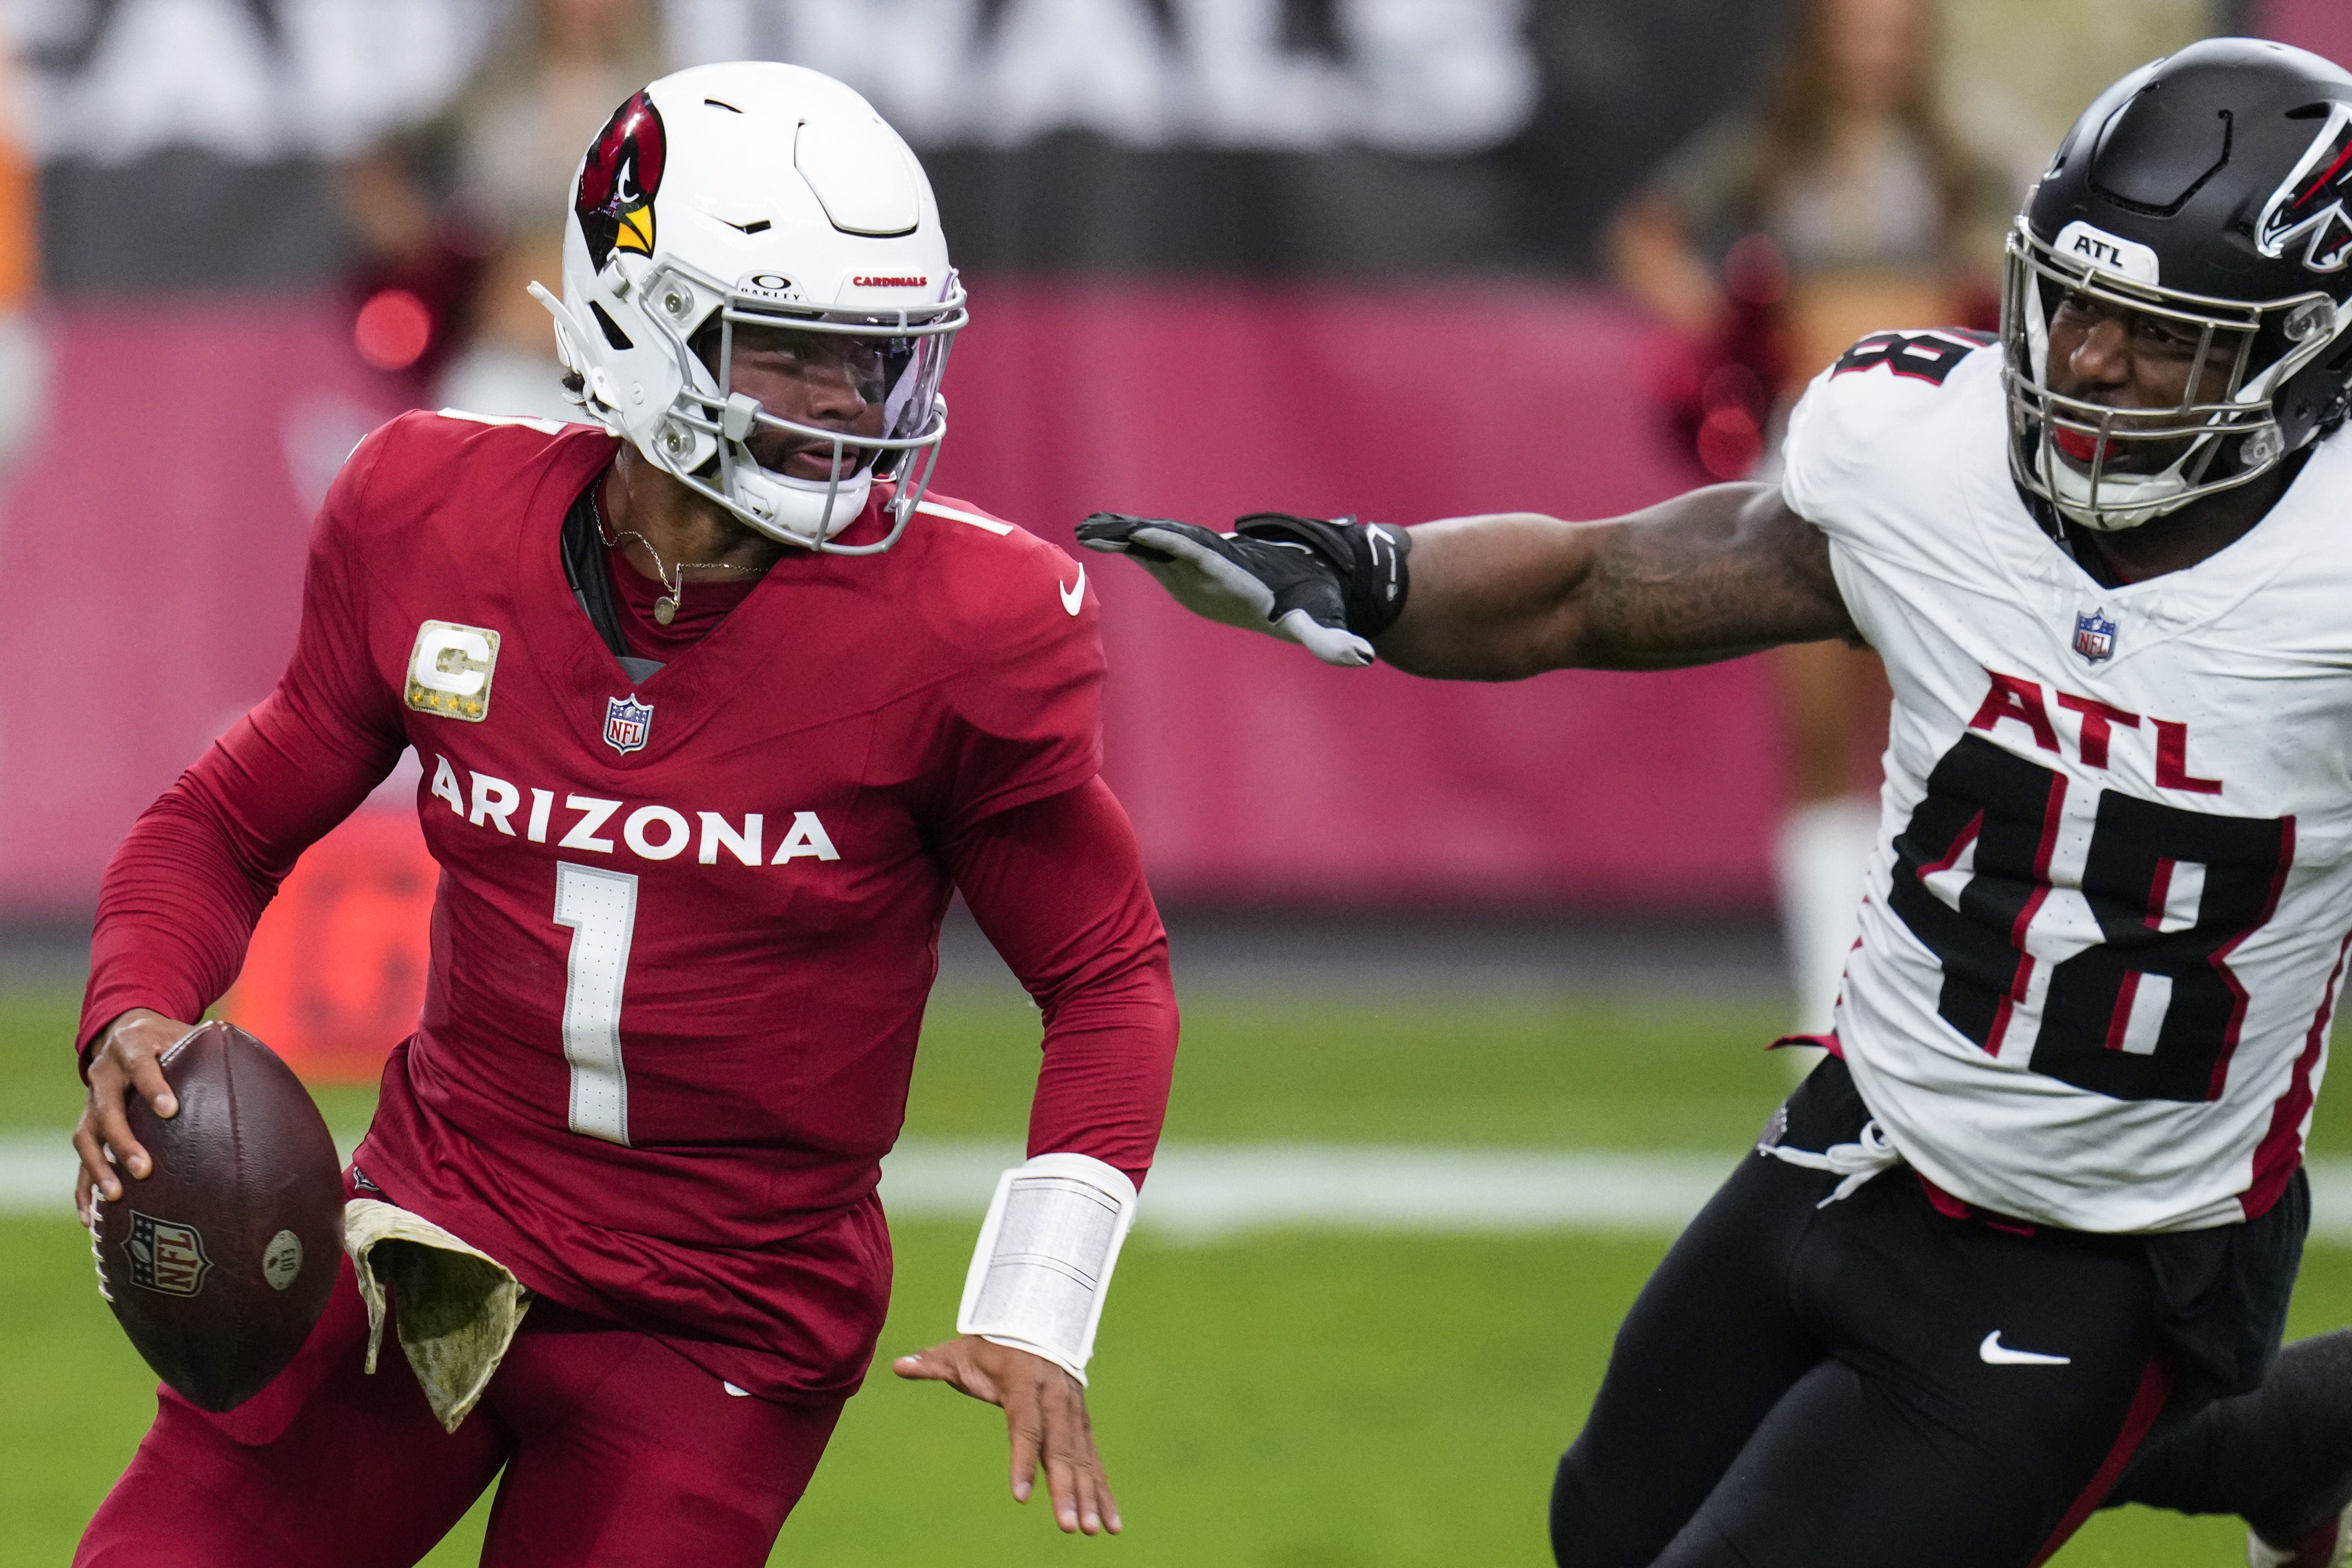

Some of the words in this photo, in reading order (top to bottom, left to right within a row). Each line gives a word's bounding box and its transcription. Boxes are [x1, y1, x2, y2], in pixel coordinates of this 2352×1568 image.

[2074, 234, 2123, 267] ATL
[853, 277, 927, 287] CARDINALS
[415, 628, 490, 696] C
[2077, 632, 2107, 655] NFL
[609, 719, 641, 745] NFL
[1968, 664, 2223, 795] ATL
[431, 753, 841, 867] ARIZONA
[1887, 731, 2296, 1103] 48
[553, 860, 639, 1148] 1
[157, 1232, 198, 1289] NFL
